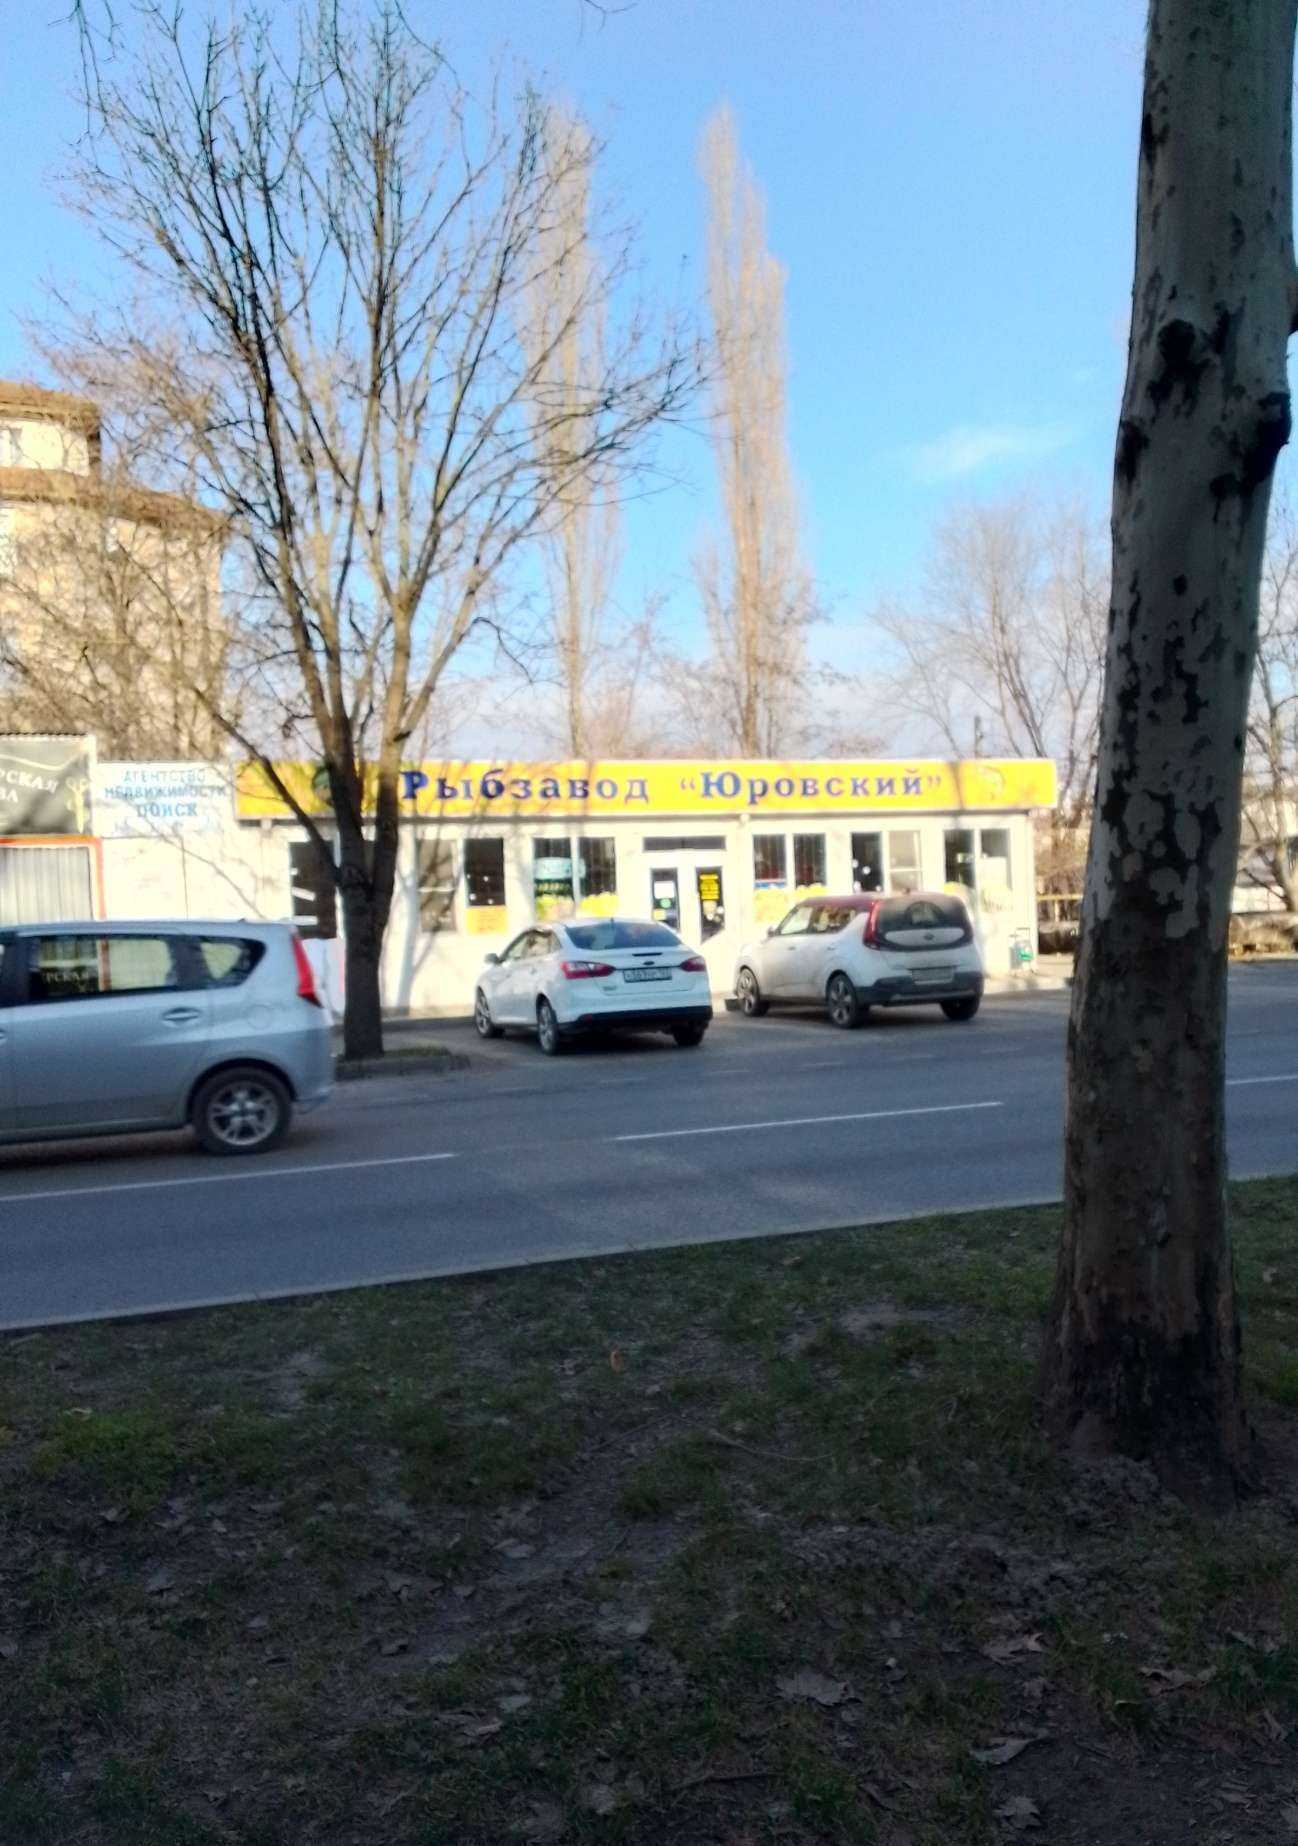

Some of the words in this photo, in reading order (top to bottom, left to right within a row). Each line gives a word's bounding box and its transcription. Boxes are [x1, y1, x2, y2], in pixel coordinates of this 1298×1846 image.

[123, 769, 206, 782] АГЕНТСТВО
[104, 784, 226, 800] НЕДВИЖИМОСТИ
[401, 768, 648, 804] Рыбзавод
[136, 801, 198, 817] ПОИСК
